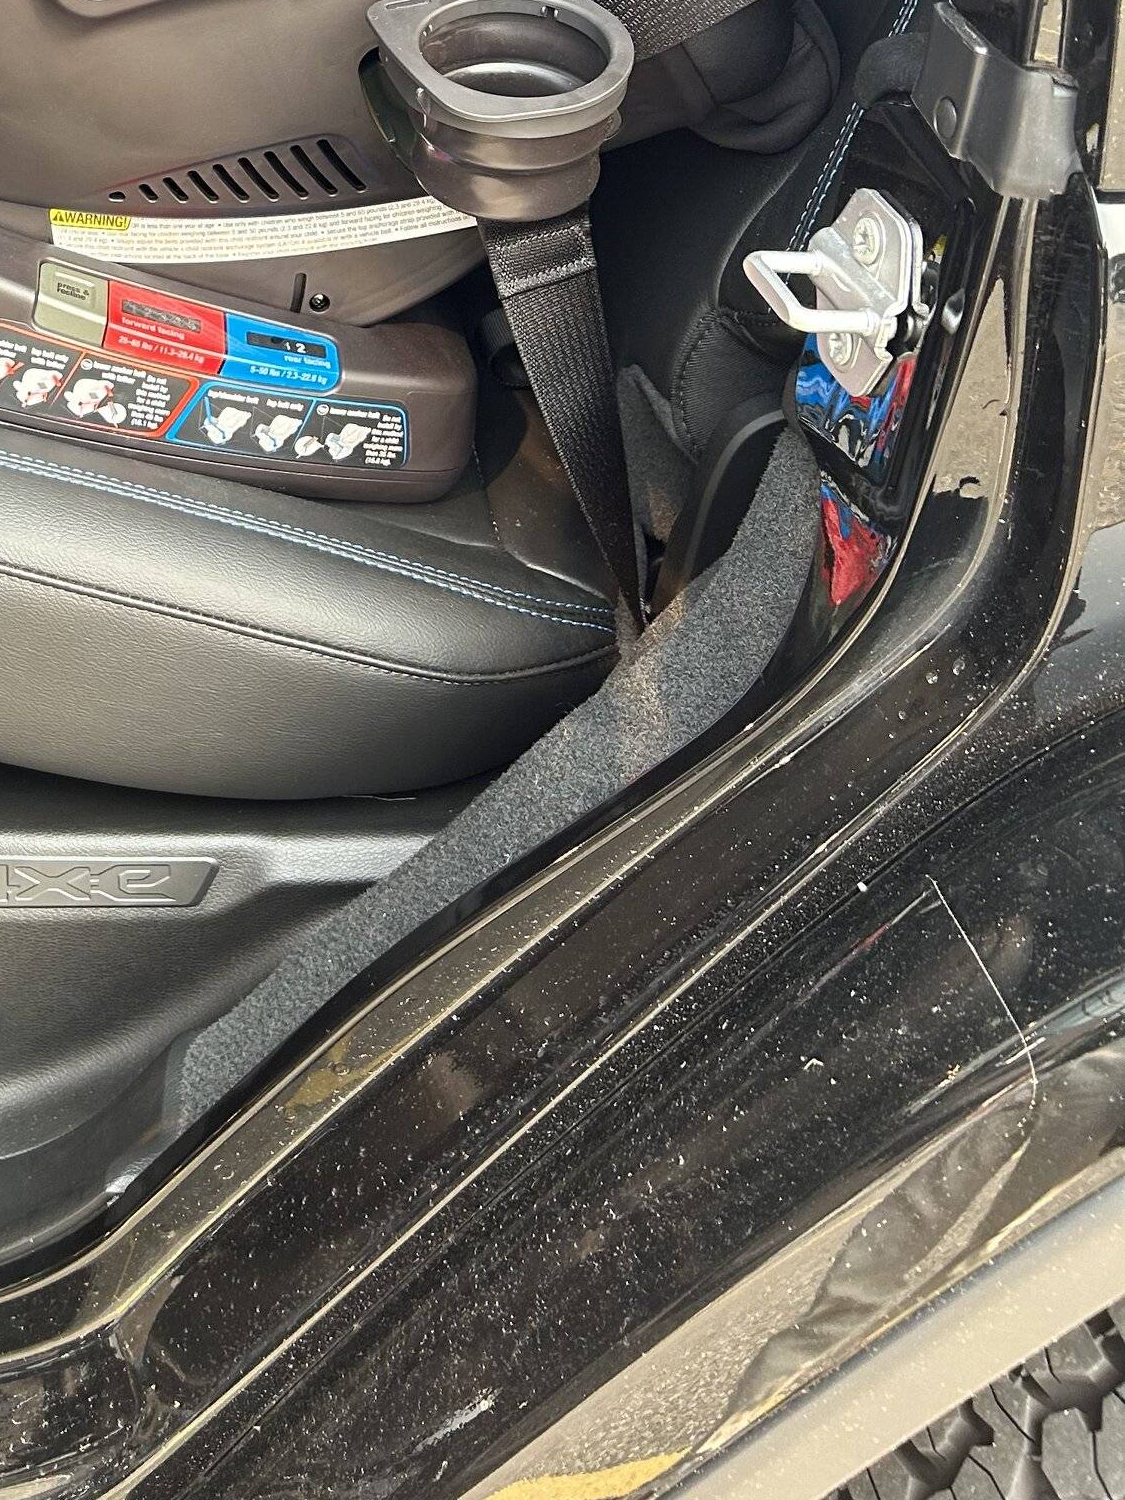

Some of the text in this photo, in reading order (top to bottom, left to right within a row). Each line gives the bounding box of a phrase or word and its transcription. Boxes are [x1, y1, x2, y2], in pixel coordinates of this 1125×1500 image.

[64, 210, 127, 228] WARNING!
[57, 282, 81, 293] press
[121, 317, 157, 332] forward
[295, 342, 307, 354] 2
